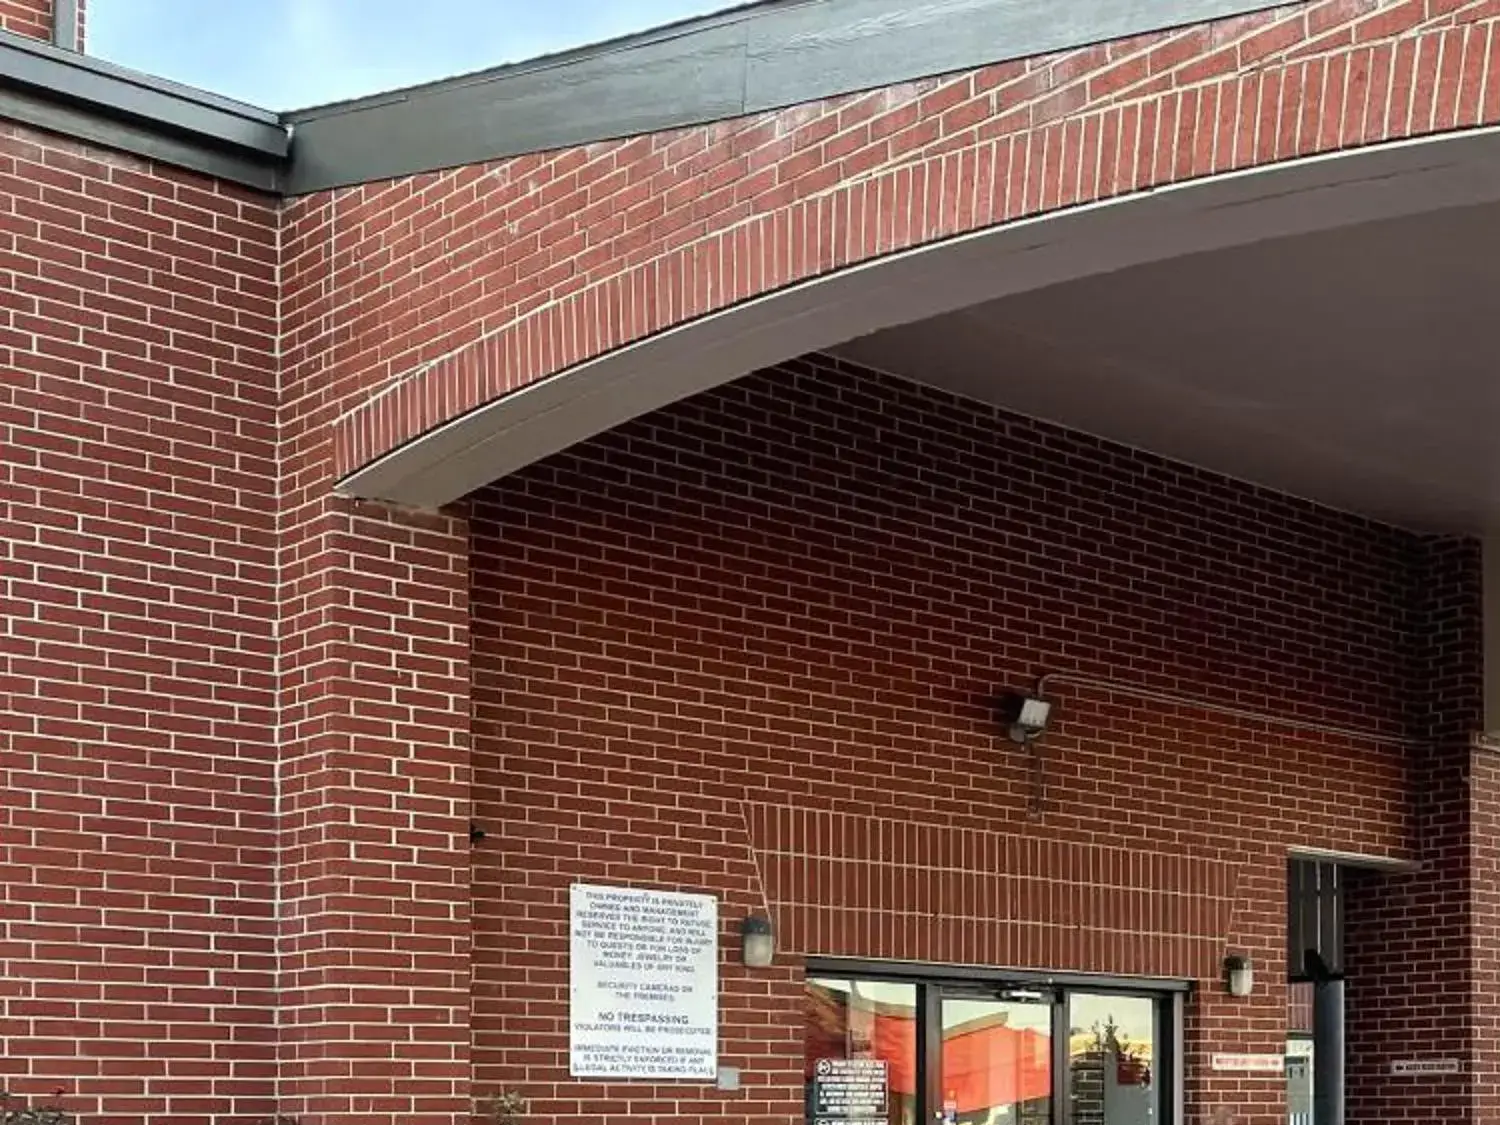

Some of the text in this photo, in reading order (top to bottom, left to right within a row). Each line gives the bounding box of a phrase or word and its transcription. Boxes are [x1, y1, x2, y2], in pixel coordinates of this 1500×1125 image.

[606, 893, 650, 903] PROPERTY
[661, 898, 702, 908] PRIVATELY
[643, 908, 699, 917] MANAGEMENT
[577, 911, 621, 921] RESERVES
[641, 916, 665, 924] RIGHT
[668, 917, 678, 925] TO
[582, 921, 618, 929] SERVICE
[608, 933, 664, 943] RESPONSIBLE
[588, 940, 598, 948] TO
[600, 942, 633, 951] GUESTS
[668, 946, 688, 954] LOSS
[594, 960, 642, 969] VALUABLES
[598, 981, 637, 990] SECURITY
[640, 983, 679, 992] CAMERAS
[599, 1012, 689, 1024] NO TRESPASSING
[575, 1023, 621, 1032] VIOLATORS
[609, 1065, 646, 1073] ACTIVITY
